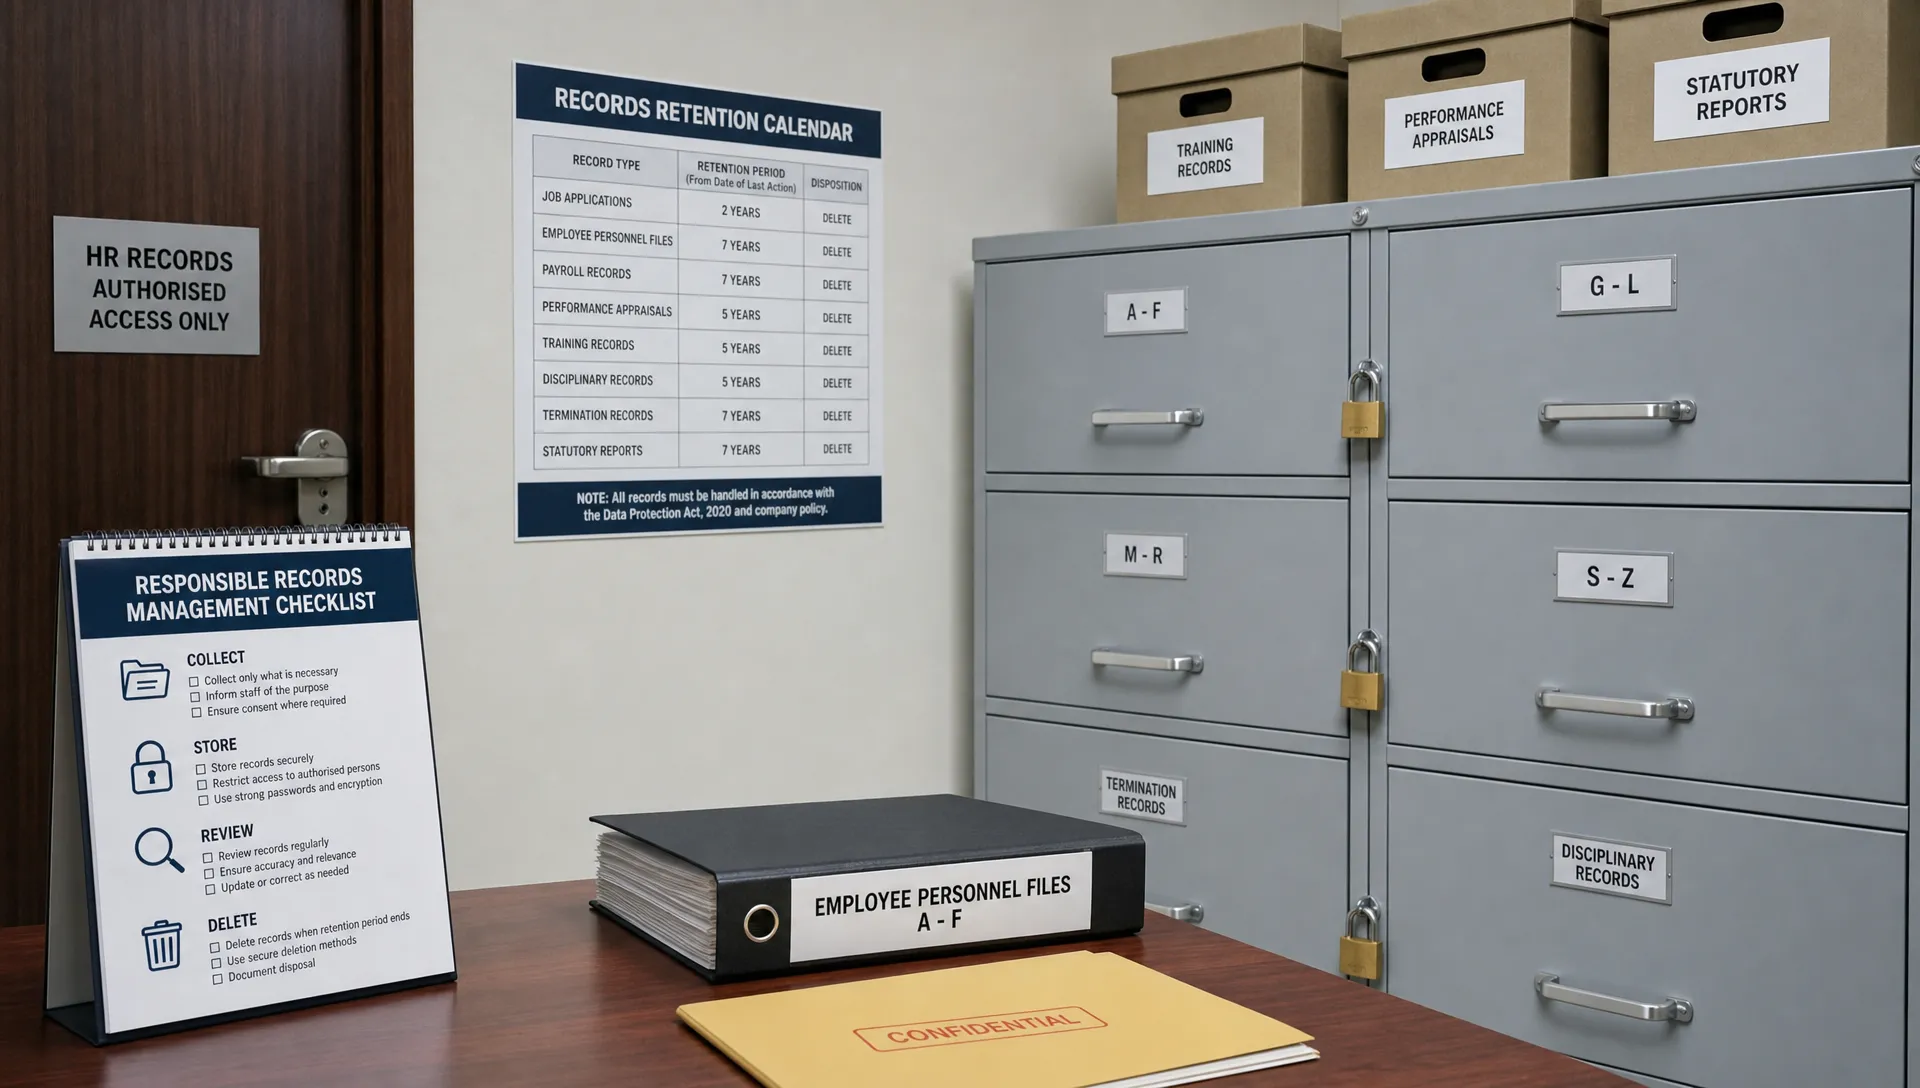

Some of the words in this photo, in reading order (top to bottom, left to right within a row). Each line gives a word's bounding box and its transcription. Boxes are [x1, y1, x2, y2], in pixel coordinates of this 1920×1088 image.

[1686, 63, 1799, 95] STATUTORY
[555, 87, 651, 118] RECORDS
[656, 100, 759, 131] RETENTION
[764, 114, 853, 142] CALENDAR
[1405, 101, 1504, 128] PERFORMANCE
[1697, 92, 1787, 120] REPORTS
[1177, 137, 1233, 158] TRAINING
[1412, 125, 1494, 149] APPRAISALS
[573, 154, 613, 168] RECORD
[616, 158, 640, 171] TYPE
[698, 161, 750, 175] RETENTION
[753, 166, 785, 178] PERIOD
[1178, 158, 1231, 178] RECORDS
[686, 174, 712, 185] (From
[714, 177, 734, 188] Date
[736, 178, 745, 188] of
[747, 179, 765, 191] Last
[767, 182, 796, 195] Action)
[811, 178, 862, 192] DISPOSITION
[542, 190, 562, 202] JOB
[564, 192, 632, 208] APPLICATIONS
[722, 204, 728, 216] 2
[730, 206, 761, 218] YEARS
[542, 227, 592, 241] EMPLOYEE
[594, 230, 647, 244] PERSONNEL
[650, 234, 673, 246] FILES
[722, 239, 727, 250] 7
[730, 240, 761, 252] YEARS
[87, 245, 119, 268] HR
[128, 247, 233, 272] RECORDS
[542, 264, 585, 277] PAYROLL
[587, 266, 631, 280] RECORDS
[722, 274, 727, 285] 7
[730, 274, 761, 287] YEARS
[92, 279, 226, 302] AUTHORISED
[1590, 275, 1604, 296] G
[1628, 273, 1639, 294] L
[542, 301, 613, 314] PERFORMANCE
[616, 304, 672, 317] APPRAISALS
[1127, 303, 1137, 321] A
[1153, 301, 1161, 319] F
[89, 309, 172, 330] ACCESS
[179, 311, 229, 331] ONLY
[542, 337, 588, 349] TRAINING
[591, 339, 635, 351] RECORDS
[543, 373, 608, 385] DISCIPLINARY
[610, 374, 653, 386] RECORDS
[542, 409, 607, 421] TERMINATION
[610, 410, 653, 421] RECORDS
[722, 410, 728, 421] 7
[730, 410, 761, 421] YEARS
[543, 445, 598, 457] STATUTORY
[600, 445, 643, 456] REPORTS
[722, 444, 728, 455] 7
[730, 444, 761, 455] YEARS
[577, 492, 609, 504] NOTE:
[612, 491, 625, 503] All
[628, 490, 667, 503] records
[669, 490, 694, 502] must
[696, 489, 709, 502] be
[711, 488, 749, 501] handled
[750, 488, 759, 500] in
[761, 487, 813, 500] accordance
[815, 486, 835, 498] with
[583, 509, 601, 521] the
[603, 508, 627, 521] Data
[629, 507, 681, 520] Protection
[683, 506, 703, 519] Act,
[706, 505, 732, 517] 2020
[734, 504, 753, 516] and
[754, 506, 798, 518] company
[799, 502, 828, 517] policy.
[1125, 545, 1137, 563] M
[1153, 546, 1162, 564] R
[135, 571, 269, 595] RESPONSIBLE
[274, 567, 363, 589] RECORDS
[1587, 565, 1600, 587] S
[1622, 567, 1634, 588] Z
[127, 596, 270, 622] MANAGEMENT
[276, 591, 376, 614] CHECKLIST
[187, 650, 245, 667] COLLECT
[204, 674, 237, 686] Collect
[239, 672, 258, 683] only
[260, 671, 283, 681] what
[285, 669, 293, 679] is
[295, 668, 338, 678] necessary
[206, 690, 237, 701] Inform
[240, 686, 261, 698] staff
[263, 685, 273, 696] of
[275, 685, 290, 695] the
[293, 683, 329, 696] purpose
[207, 706, 239, 716] Ensure
[242, 702, 278, 713] consent
[280, 700, 308, 710] where
[310, 695, 346, 708] required
[194, 737, 237, 754] STORE
[211, 762, 237, 773] Store
[240, 757, 275, 769] records
[277, 753, 314, 766] securely
[213, 776, 250, 788] Restrict
[252, 773, 283, 784] access
[285, 772, 295, 780] to
[298, 765, 345, 779] authorised
[347, 763, 380, 776] persons
[214, 794, 232, 804] Use
[234, 791, 265, 802] strong
[267, 784, 316, 800] passwords
[319, 781, 335, 792] and
[337, 777, 383, 790] encryption
[1106, 776, 1176, 799] TERMINATION
[1118, 795, 1166, 815] RECORDS
[201, 823, 253, 843] REVIEW
[218, 849, 252, 861] Review
[254, 843, 289, 856] records
[291, 837, 329, 852] regularly
[1562, 843, 1655, 871] DISCIPLINARY
[220, 865, 252, 877] Ensure
[254, 859, 295, 872] accuracy
[297, 854, 314, 866] and
[316, 851, 357, 863] relevance
[221, 880, 255, 894] Update
[257, 879, 267, 887] or
[269, 872, 302, 885] correct
[305, 872, 315, 880] as
[317, 864, 349, 878] needed
[1576, 865, 1639, 889] RECORDS
[815, 889, 911, 917] EMPLOYEE
[918, 880, 1022, 907] PERSONNEL
[1027, 875, 1071, 896] FILES
[208, 912, 257, 933] DELETE
[225, 938, 255, 950] Delete
[258, 931, 292, 945] records
[294, 928, 318, 939] when
[320, 920, 360, 935] retention
[361, 914, 388, 930] period
[390, 911, 410, 923] ends
[917, 912, 930, 932] A
[952, 908, 962, 928] F
[227, 956, 245, 966] Use
[248, 950, 279, 963] secure
[281, 944, 317, 957] deletion
[319, 935, 357, 950] methods
[228, 965, 277, 982] Document
[279, 957, 316, 973] disposal
[886, 1013, 1082, 1044] CONFIDENTIAL
